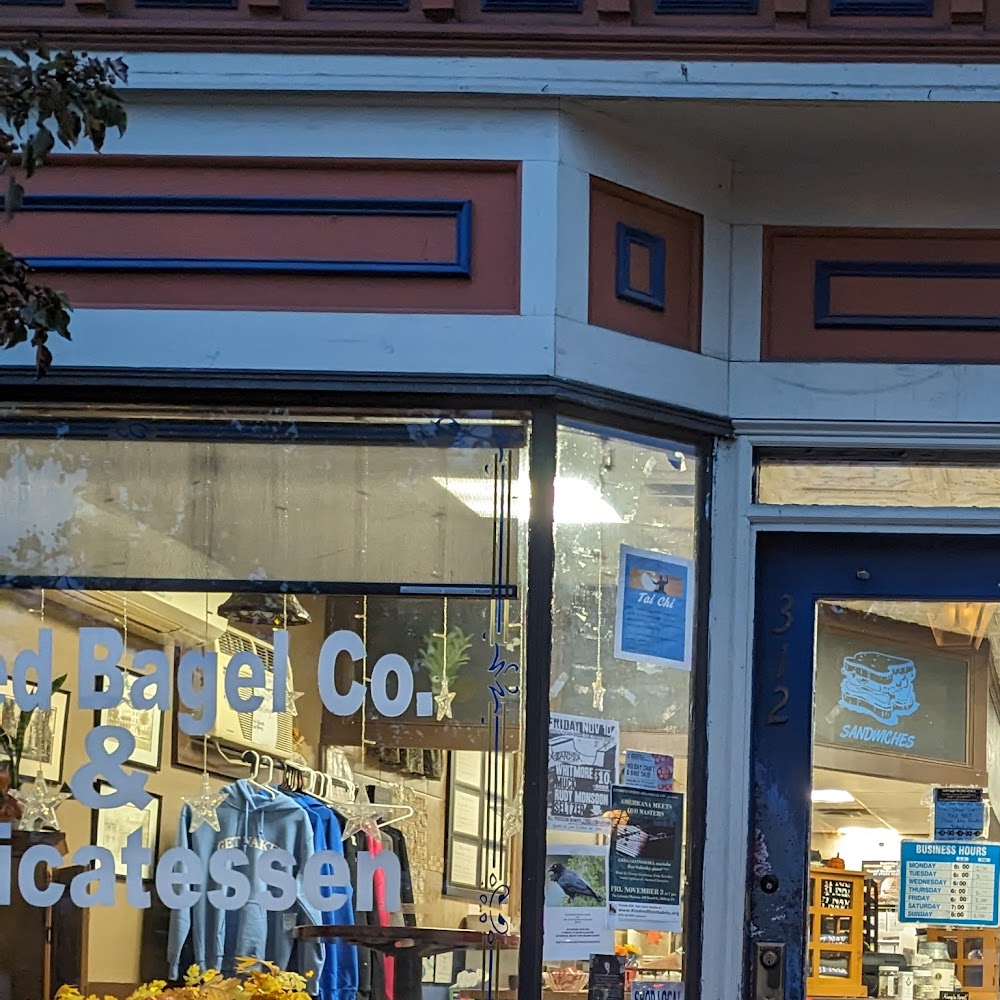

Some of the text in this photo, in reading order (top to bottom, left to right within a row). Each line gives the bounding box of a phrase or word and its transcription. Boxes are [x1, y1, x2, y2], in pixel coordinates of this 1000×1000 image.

[637, 592, 676, 609] Tai Chi
[0, 626, 434, 736] d Bagel Co.
[549, 717, 581, 733] FRIDAY
[582, 721, 600, 735] NOV
[840, 724, 916, 749] SANDWICHES
[70, 725, 153, 811] &
[555, 764, 594, 780] WHITMORE
[554, 788, 573, 802] RUDY
[574, 790, 609, 806] MONSOON
[217, 836, 242, 851] GET
[915, 844, 988, 857] BUSINESS HOURS
[0, 822, 402, 912] icatessen
[624, 886, 660, 895] NOVEMBER
[908, 878, 948, 886] WEDNESDAY
[908, 886, 942, 894] THURSDAY
